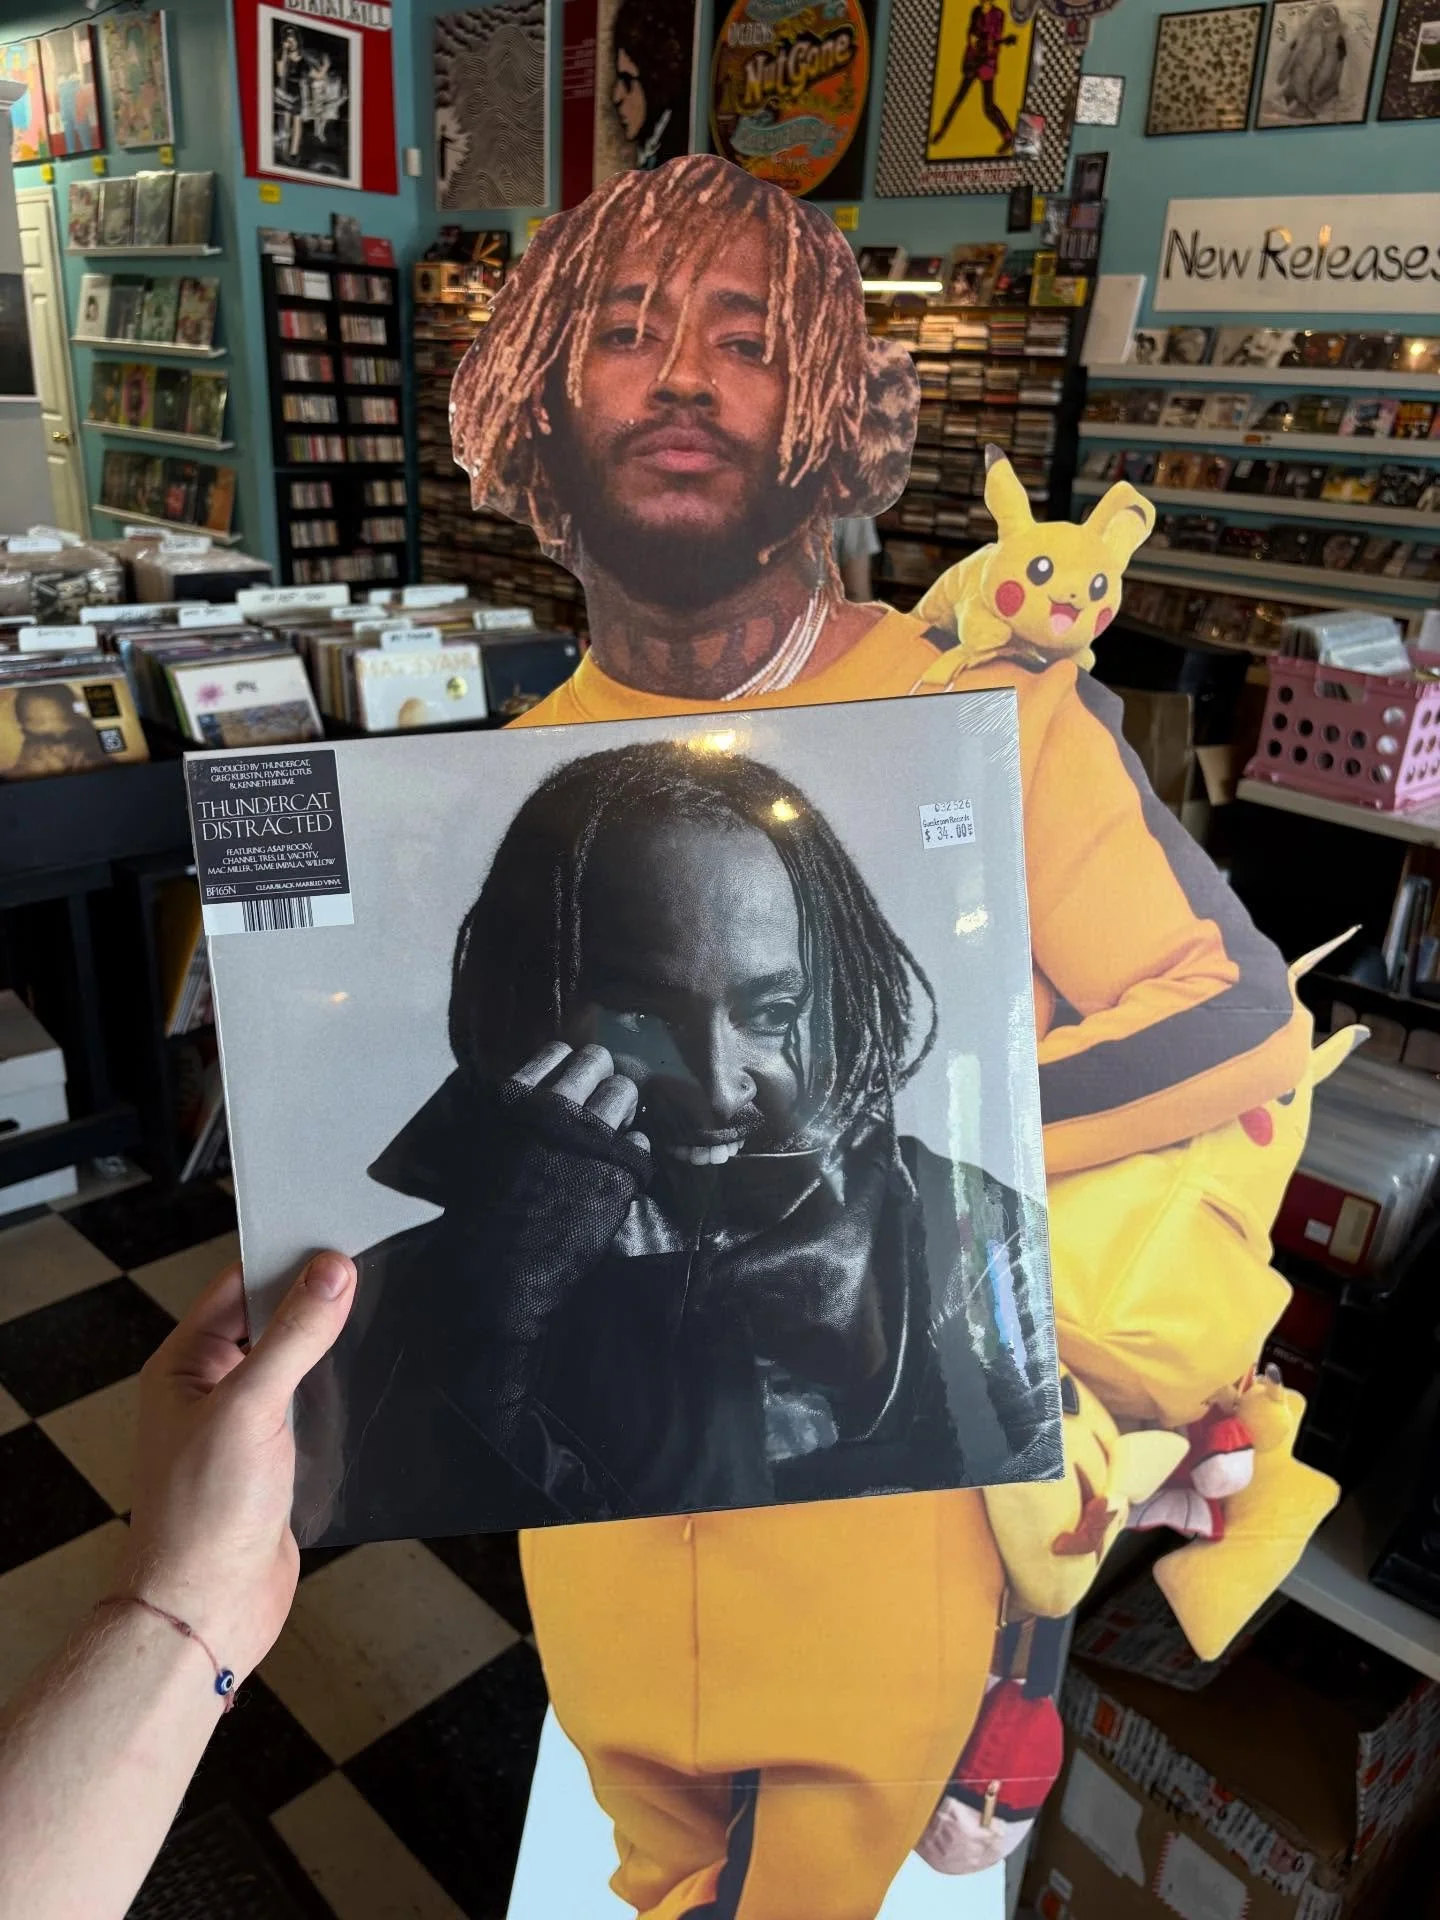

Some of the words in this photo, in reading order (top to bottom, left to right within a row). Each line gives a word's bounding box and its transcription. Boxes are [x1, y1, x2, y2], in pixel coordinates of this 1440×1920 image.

[1163, 227, 1255, 281] New
[210, 763, 249, 774] PRODUCED
[250, 762, 260, 772] BY
[211, 773, 232, 783] GREG
[265, 770, 289, 780] FLYING
[289, 768, 313, 778] LOTUS
[229, 782, 237, 790] &
[237, 780, 270, 789] KENNETH
[271, 777, 296, 786] BLUME
[197, 792, 332, 819] THUNDERCAT
[202, 813, 333, 841] DISTRACTED
[924, 828, 931, 842] $
[226, 846, 266, 856] FEATURING
[207, 865, 227, 875] MAC
[254, 862, 275, 872] TAME
[305, 857, 336, 868] WILLOW
[222, 856, 258, 866] CHANNEL
[206, 885, 237, 897] BF165N
[323, 877, 342, 887] VINYL
